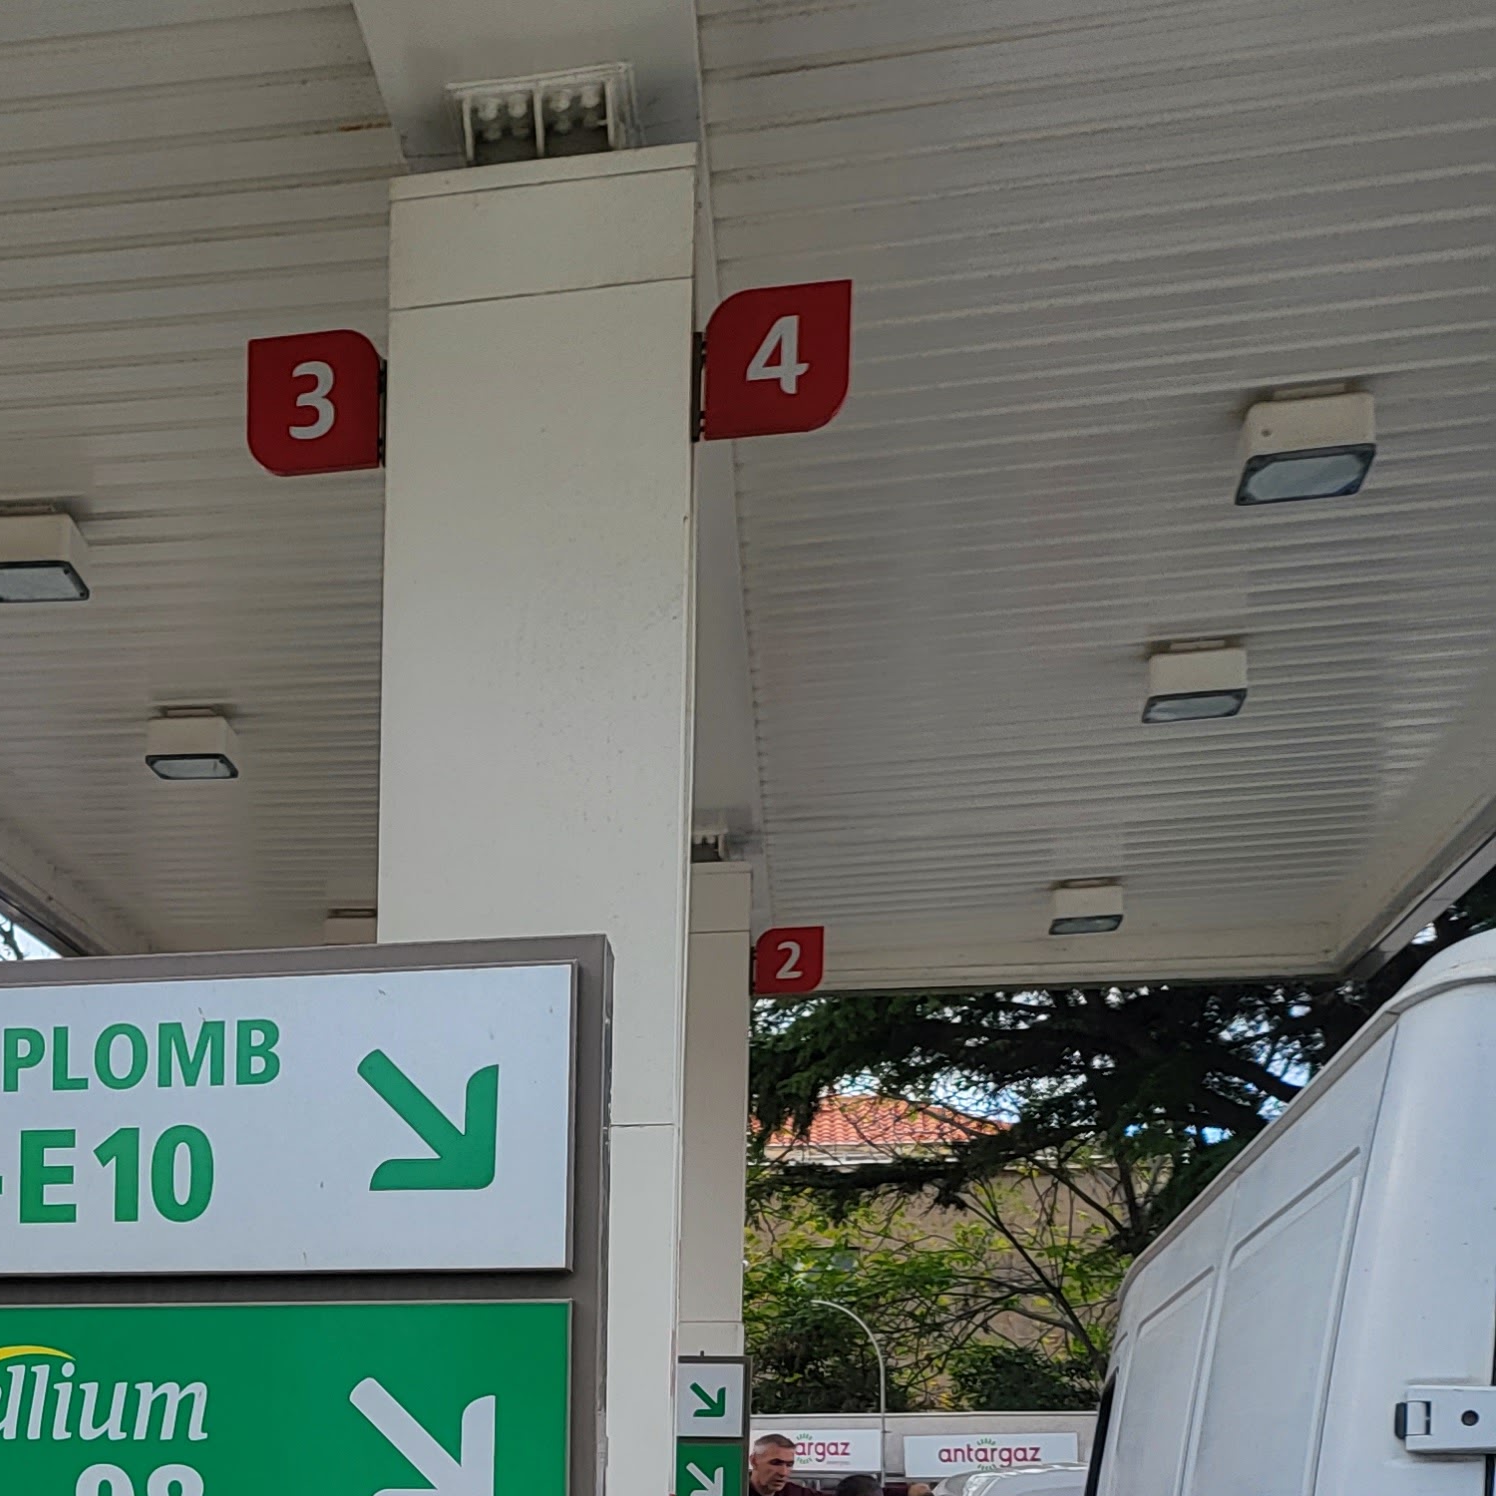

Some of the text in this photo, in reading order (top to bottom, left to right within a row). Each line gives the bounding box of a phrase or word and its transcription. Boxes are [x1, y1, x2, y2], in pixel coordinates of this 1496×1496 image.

[745, 313, 809, 395] 4
[288, 361, 335, 440] 3
[775, 939, 803, 979] 2
[2, 1017, 282, 1094] PLOMB
[938, 1444, 1041, 1468] antargaz
